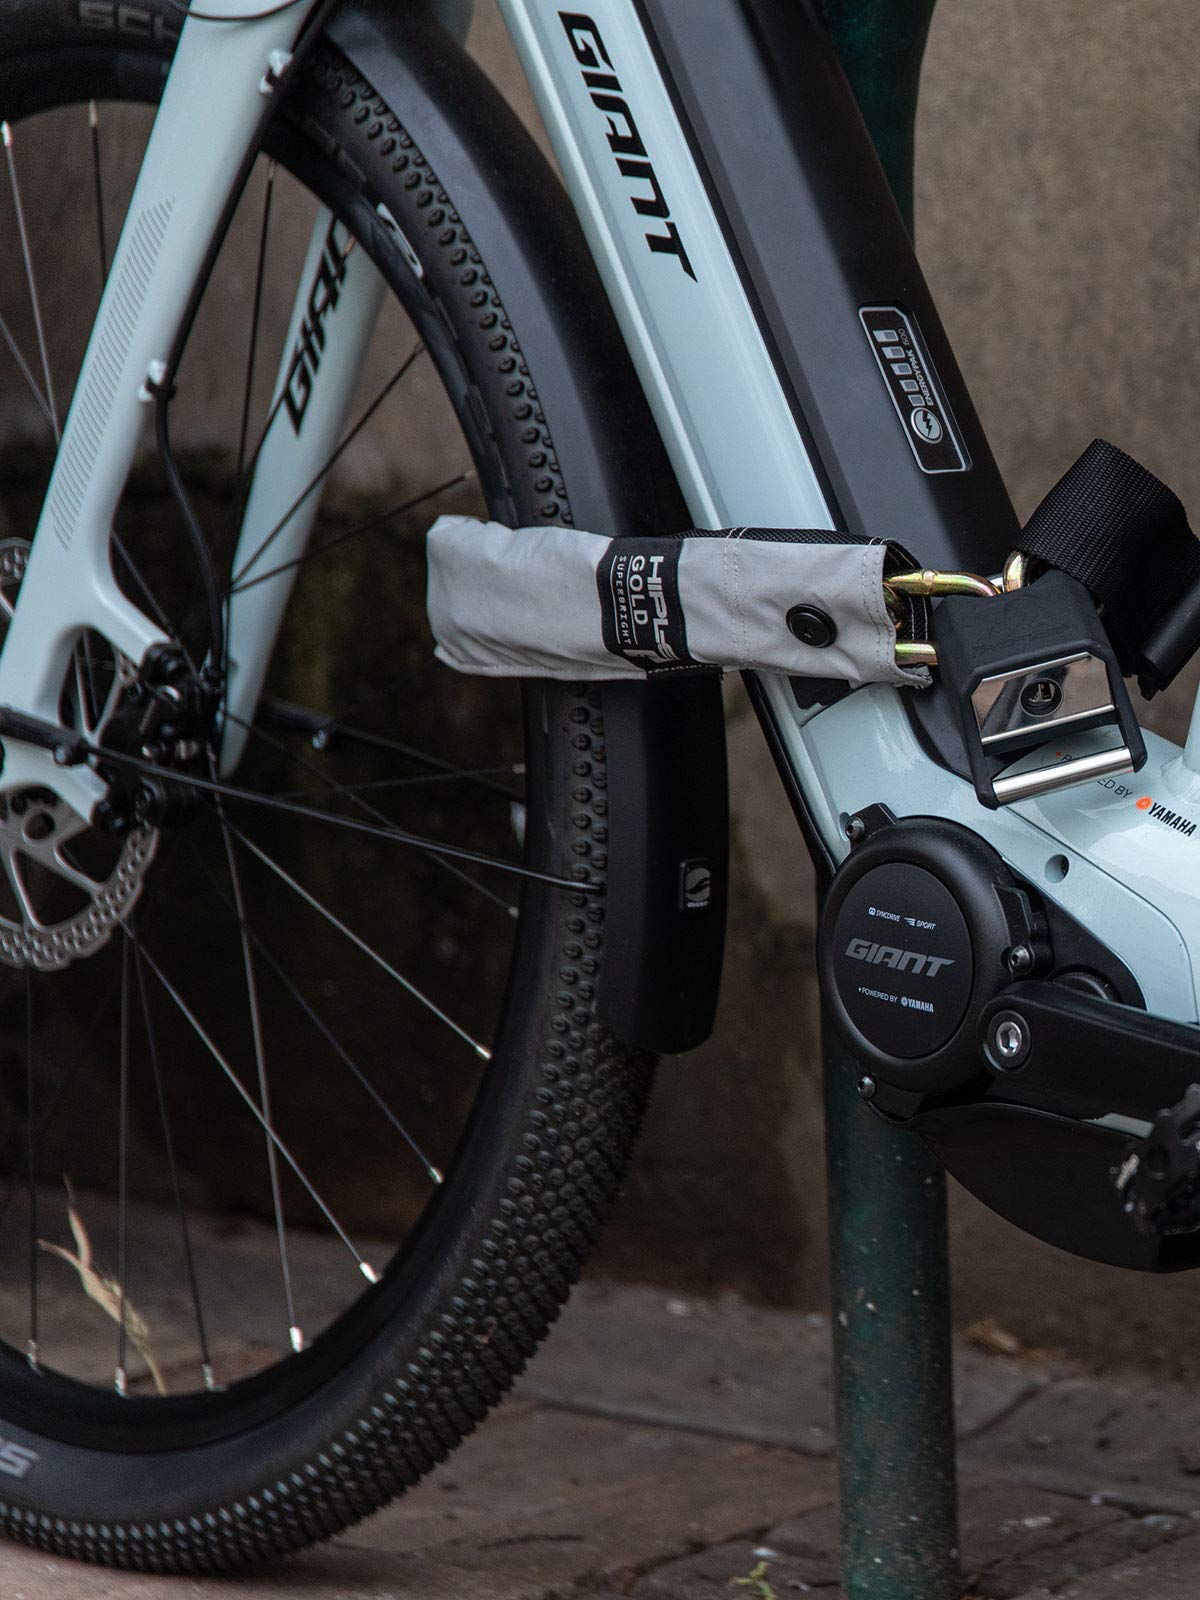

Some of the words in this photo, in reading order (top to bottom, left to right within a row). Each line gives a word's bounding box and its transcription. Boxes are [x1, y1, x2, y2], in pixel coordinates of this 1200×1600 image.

[558, 10, 699, 283] GIANT
[905, 348, 934, 406] ENERGYPAK
[616, 555, 632, 645] SUPERBRIGHT
[630, 555, 648, 625] GOLD
[1115, 785, 1134, 799] BY
[1148, 802, 1198, 837] YAMAHA
[875, 909, 901, 922] SYNCDRIVE
[916, 920, 936, 930] SPORT
[845, 937, 956, 977] GIANT
[861, 987, 889, 1001] POWERED
[889, 995, 898, 1003] BY
[907, 998, 934, 1013] YAMAHA
